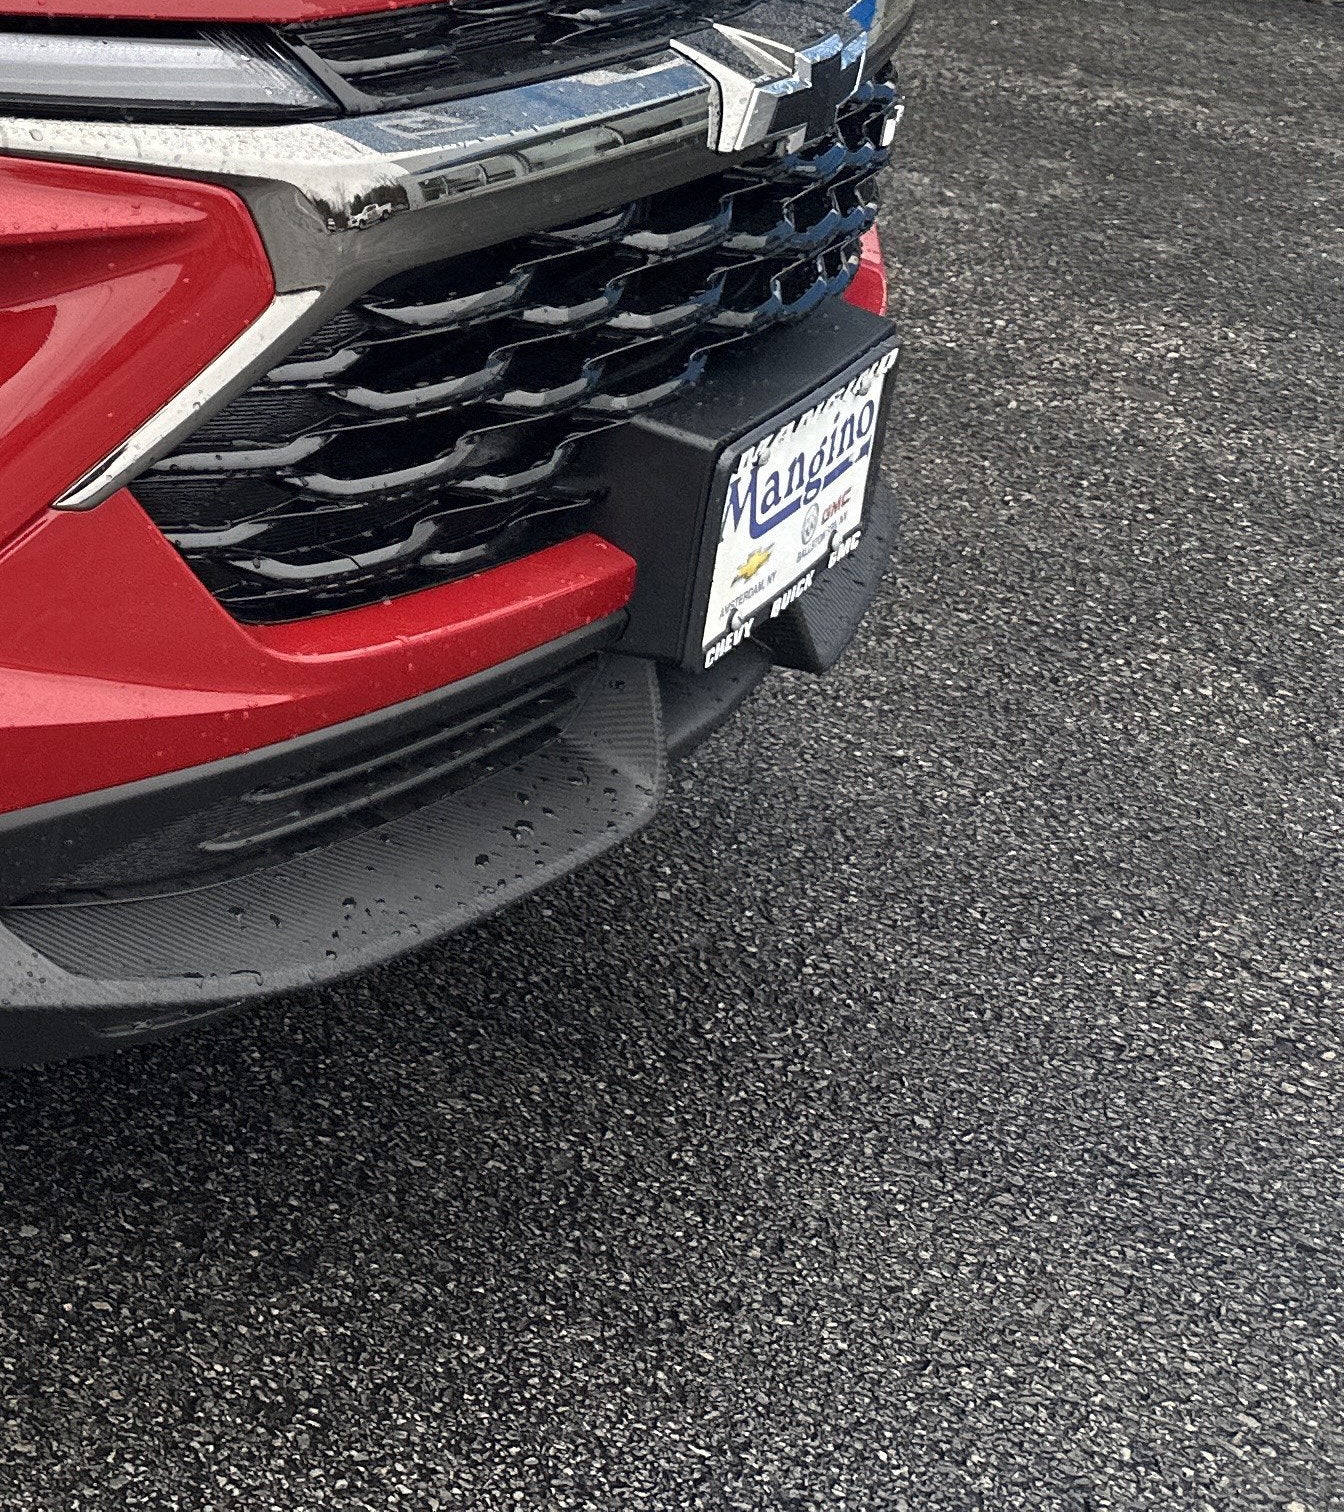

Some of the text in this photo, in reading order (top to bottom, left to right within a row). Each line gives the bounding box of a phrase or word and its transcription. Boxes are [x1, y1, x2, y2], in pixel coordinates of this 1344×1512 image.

[721, 398, 875, 540] Mangino
[821, 486, 853, 525] GMC
[703, 530, 862, 669] CHEVY BUICK GMC
